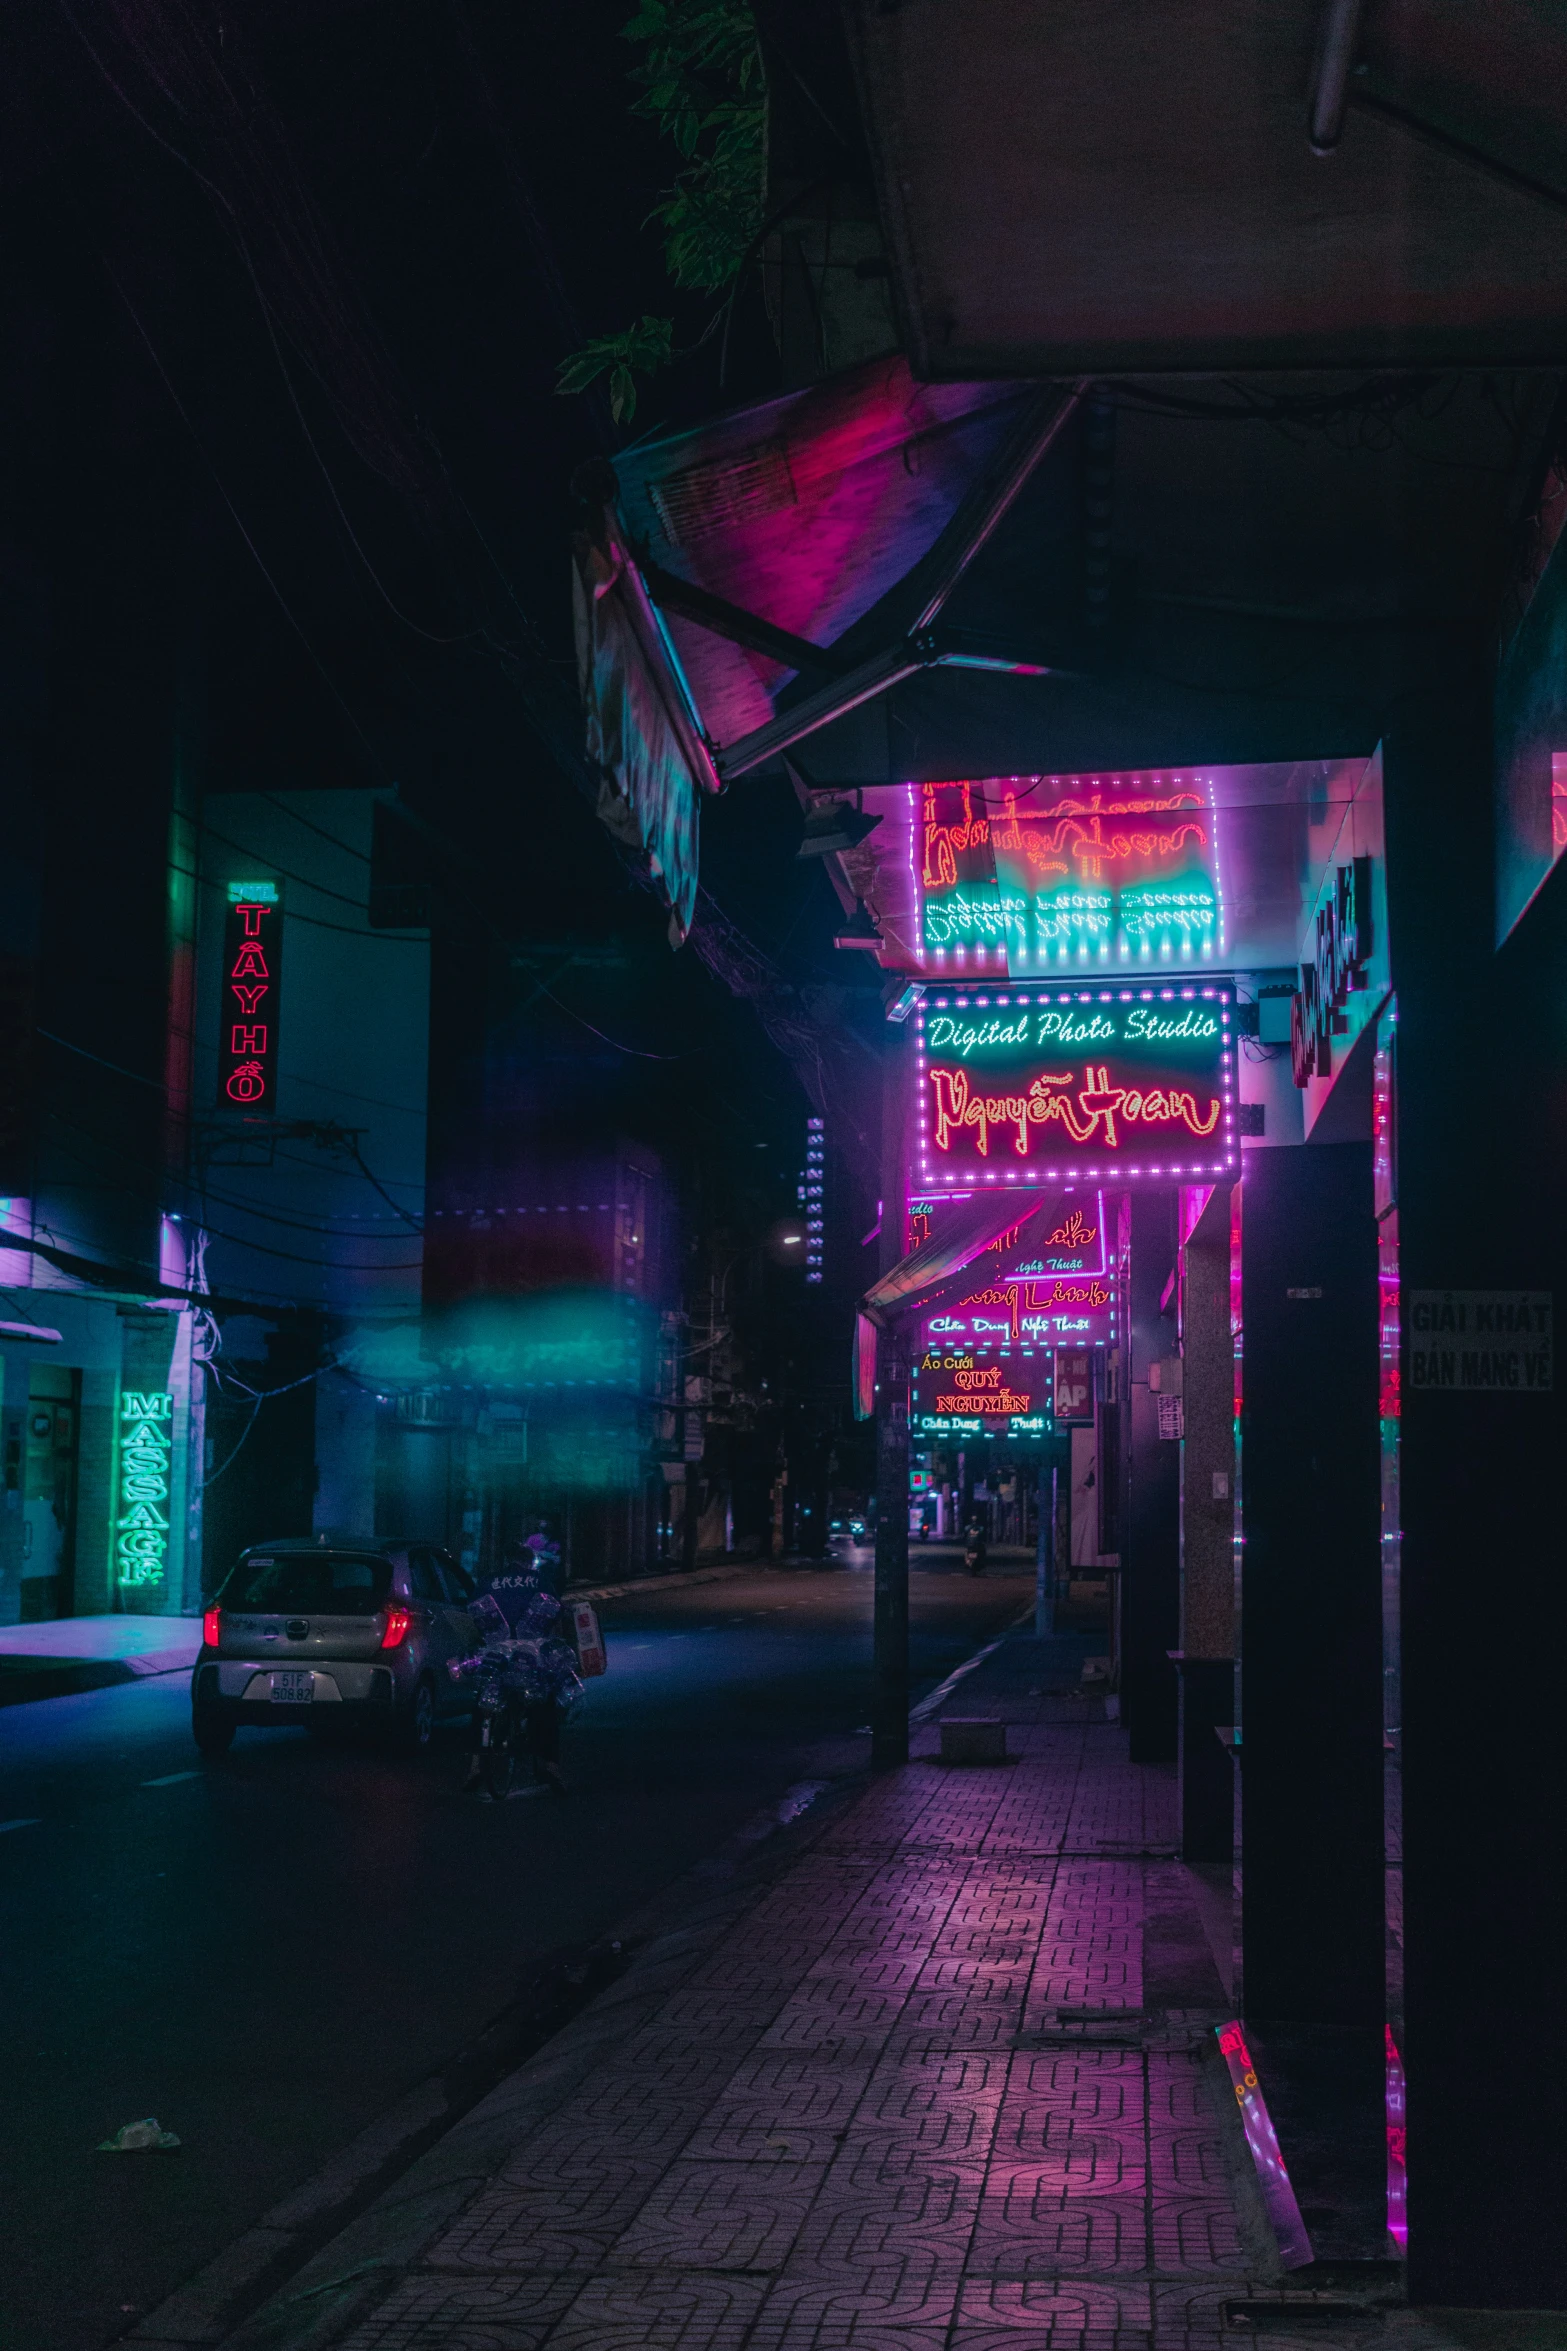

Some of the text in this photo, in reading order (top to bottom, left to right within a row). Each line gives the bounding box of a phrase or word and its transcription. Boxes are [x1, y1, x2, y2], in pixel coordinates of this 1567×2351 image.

[226, 904, 271, 1102] TÂY HỒ
[928, 1009, 1218, 1056] Digital Photo Studio
[929, 1068, 1099, 1156] Nguyễn
[1046, 1258, 1083, 1272] Thuật
[1025, 1281, 1109, 1310] Linh
[1412, 1293, 1550, 1332] GIẢI KHÁT
[928, 1315, 966, 1332] Chân
[971, 1317, 1010, 1340] Dung
[1021, 1315, 1050, 1340] Nghệ
[921, 1354, 975, 1370] Áo Cưới
[1413, 1337, 1550, 1388] BÁN MANG VỀ
[953, 1366, 1003, 1391] QUÝ
[935, 1388, 1030, 1413] NGUYỄN
[1056, 1378, 1087, 1413] ẬP
[921, 1416, 950, 1430] Chân
[951, 1417, 983, 1431] Dung
[1010, 1416, 1045, 1431] Thuật
[117, 1391, 173, 1586] MASSAGE
[282, 1673, 304, 1687] 51F
